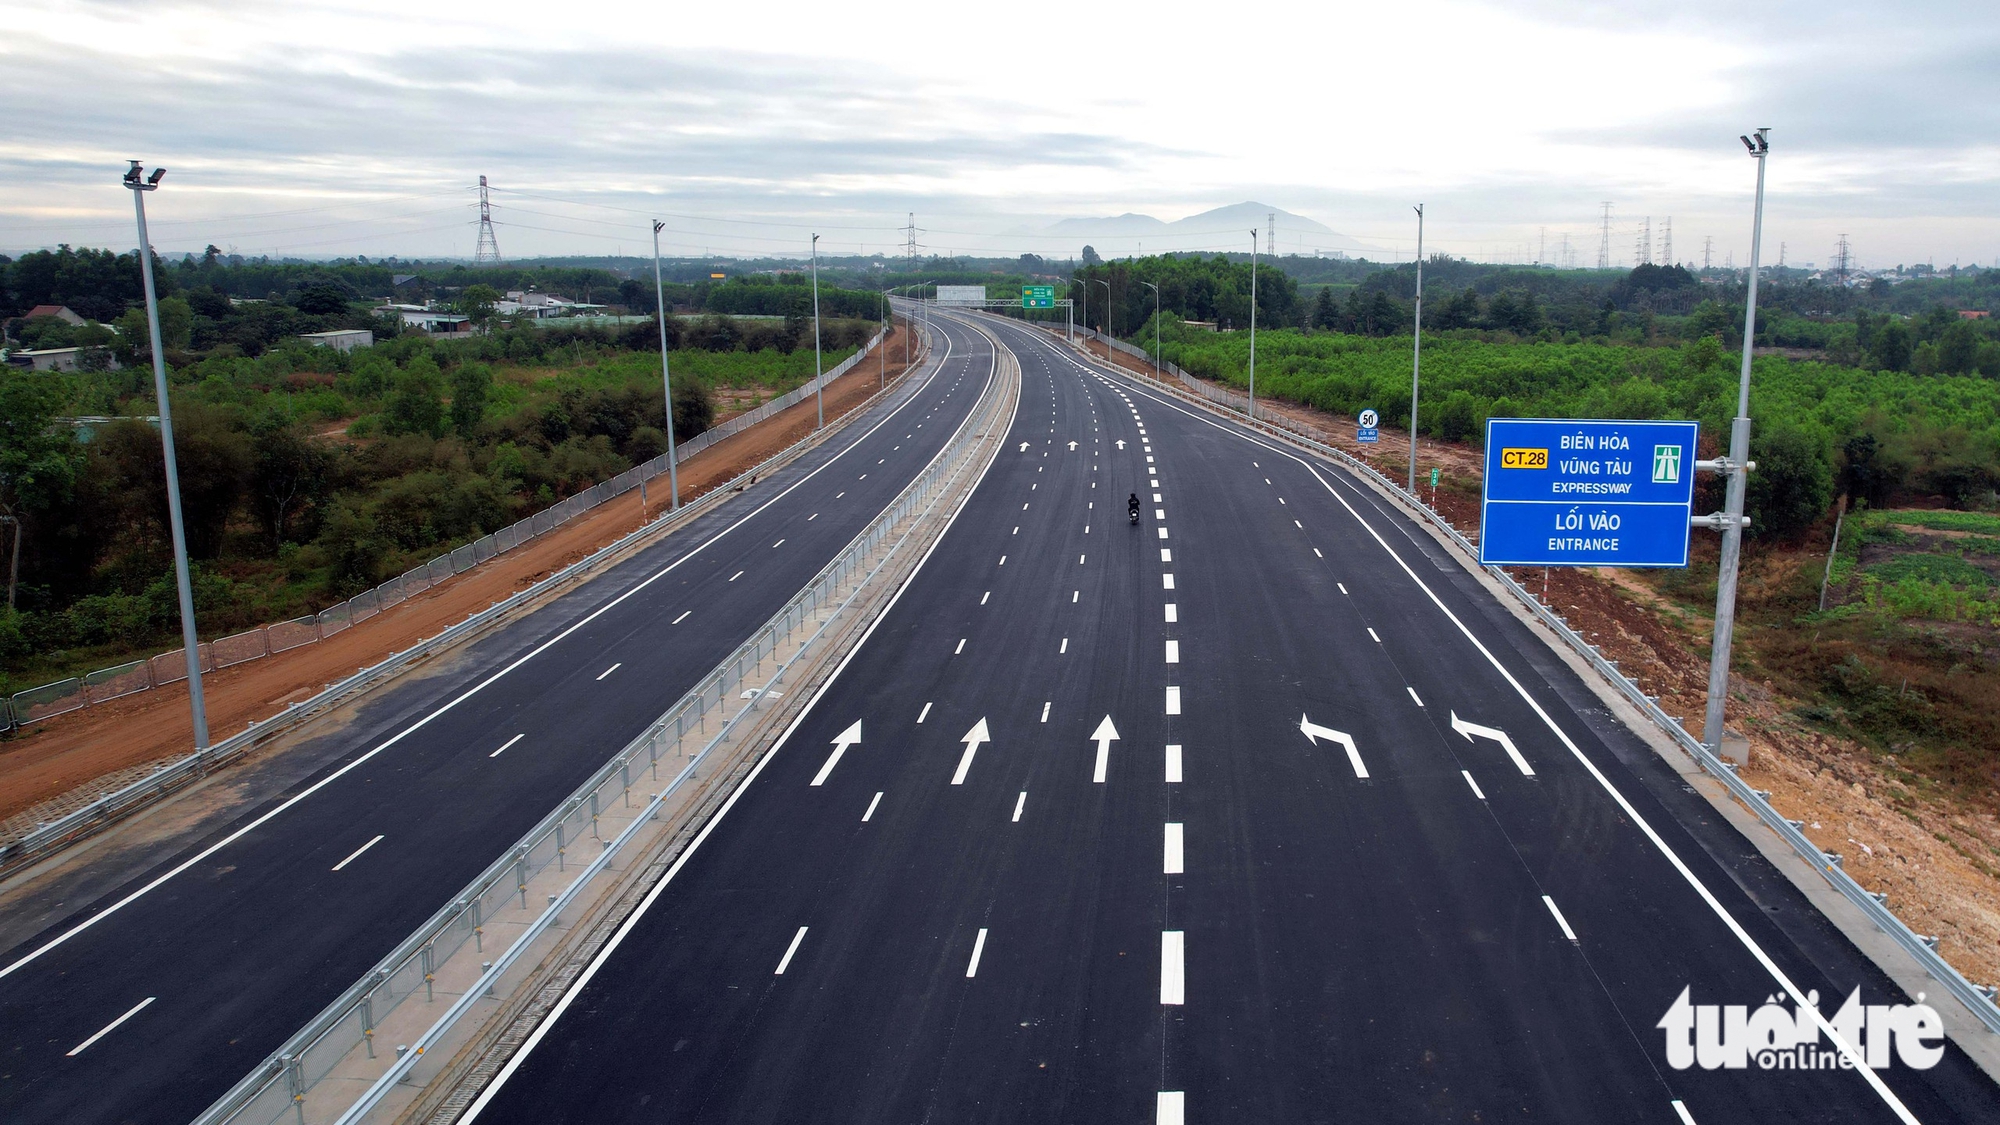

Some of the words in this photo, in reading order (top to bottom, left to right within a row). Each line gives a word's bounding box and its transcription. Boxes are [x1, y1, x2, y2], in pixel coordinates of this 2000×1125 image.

[1363, 414, 1374, 425] 50
[1561, 431, 1594, 450] BIÊN
[1600, 432, 1630, 450] HÒA
[1504, 452, 1545, 466] CT.28
[1560, 457, 1600, 475] VŨNG
[1605, 457, 1632, 475] TÀU
[1552, 482, 1632, 494] EXPRESSWAY
[1555, 506, 1583, 530] LỐI
[1589, 510, 1621, 531] VÀO
[1548, 538, 1619, 551] ENTRANCE
